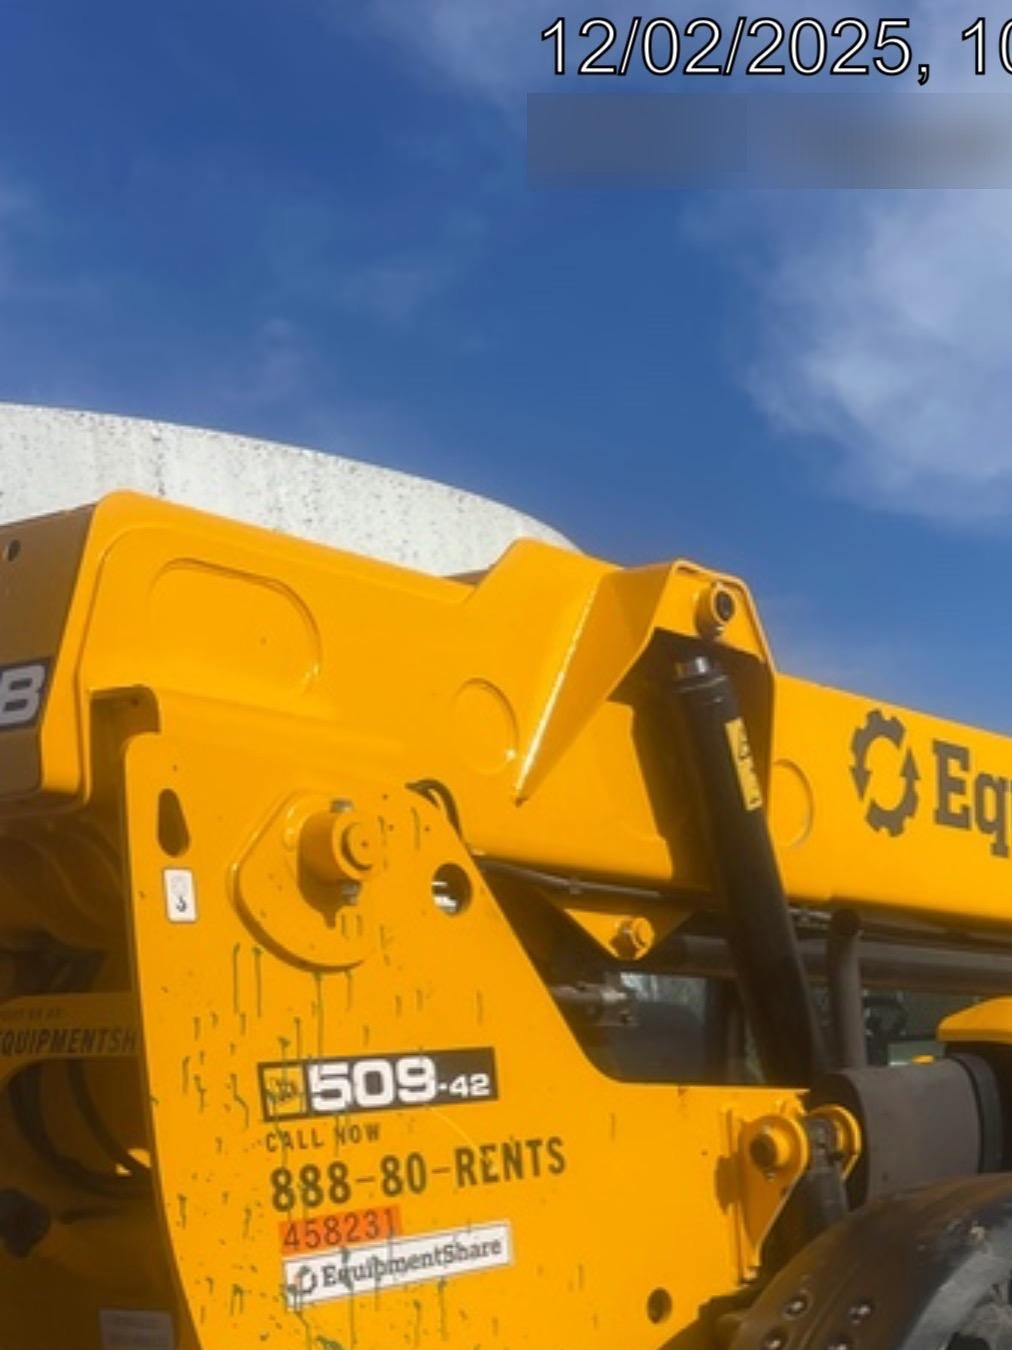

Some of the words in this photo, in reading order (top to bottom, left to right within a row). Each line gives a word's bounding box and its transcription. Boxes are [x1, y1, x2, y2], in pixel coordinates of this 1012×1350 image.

[0, 1027, 138, 1056] QUIPMENTSH
[308, 1056, 490, 1111] 509-42
[265, 1127, 324, 1153] CALL
[334, 1122, 381, 1145] NOW
[270, 1136, 566, 1213] 888-80-RENTS
[283, 1207, 395, 1251] 458231
[321, 1237, 502, 1289] EquipmentShare
